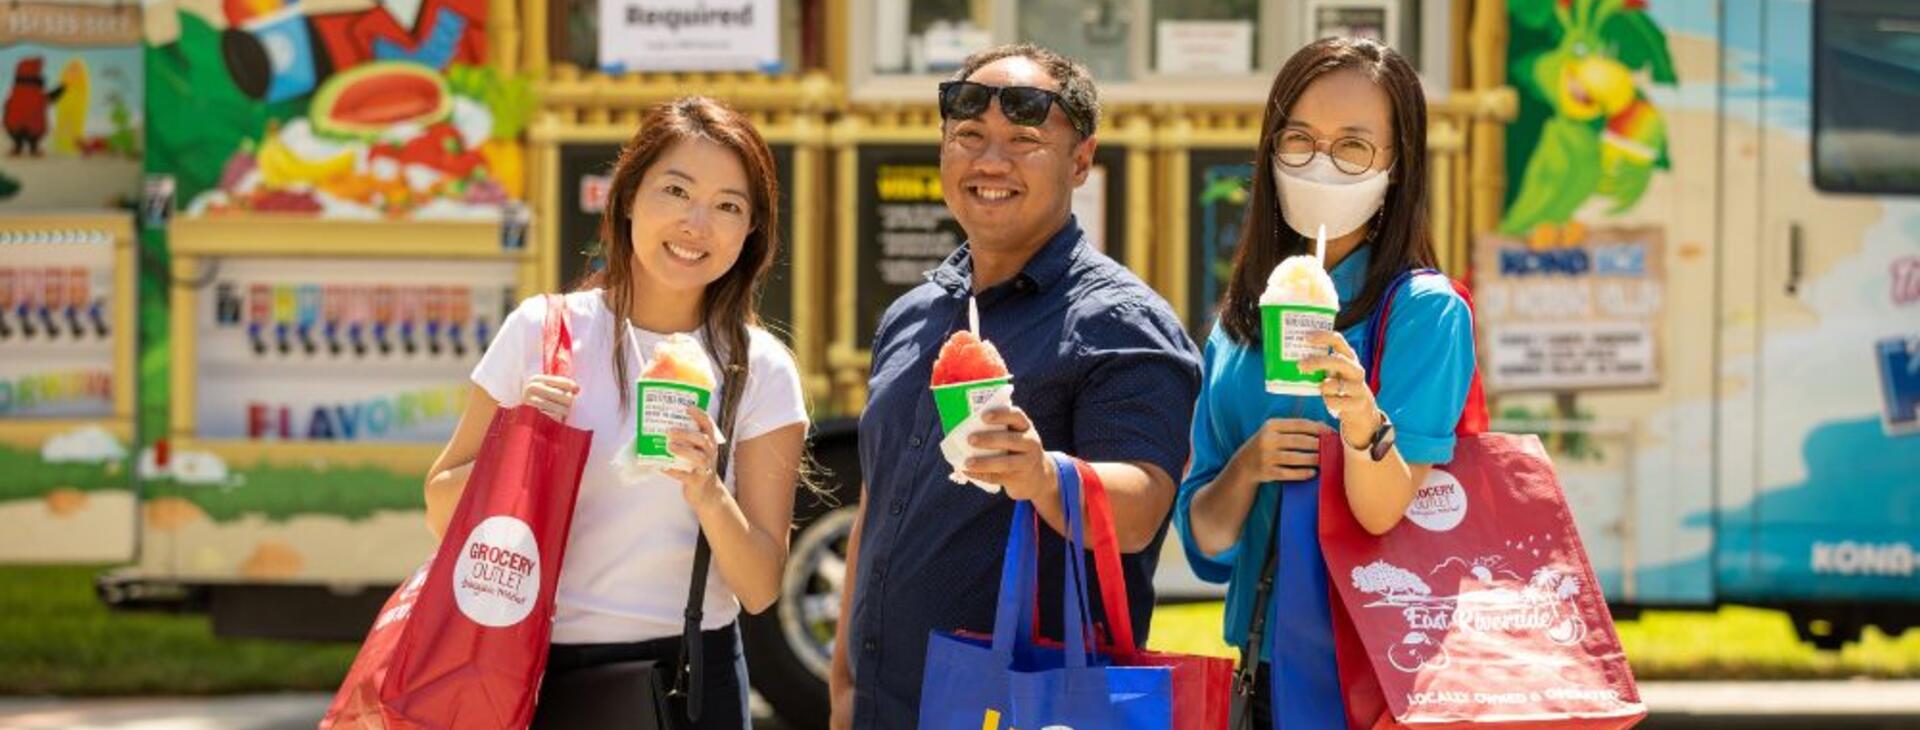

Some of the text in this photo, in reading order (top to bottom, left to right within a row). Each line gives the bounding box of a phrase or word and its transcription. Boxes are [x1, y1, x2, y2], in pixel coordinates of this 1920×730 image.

[625, 4, 754, 33] Required
[470, 542, 536, 576] GROCERY
[472, 562, 523, 590] OUTLET
[1403, 606, 1450, 630] East
[1407, 691, 1470, 706] LOCALLY
[1474, 692, 1527, 705] OWNED
